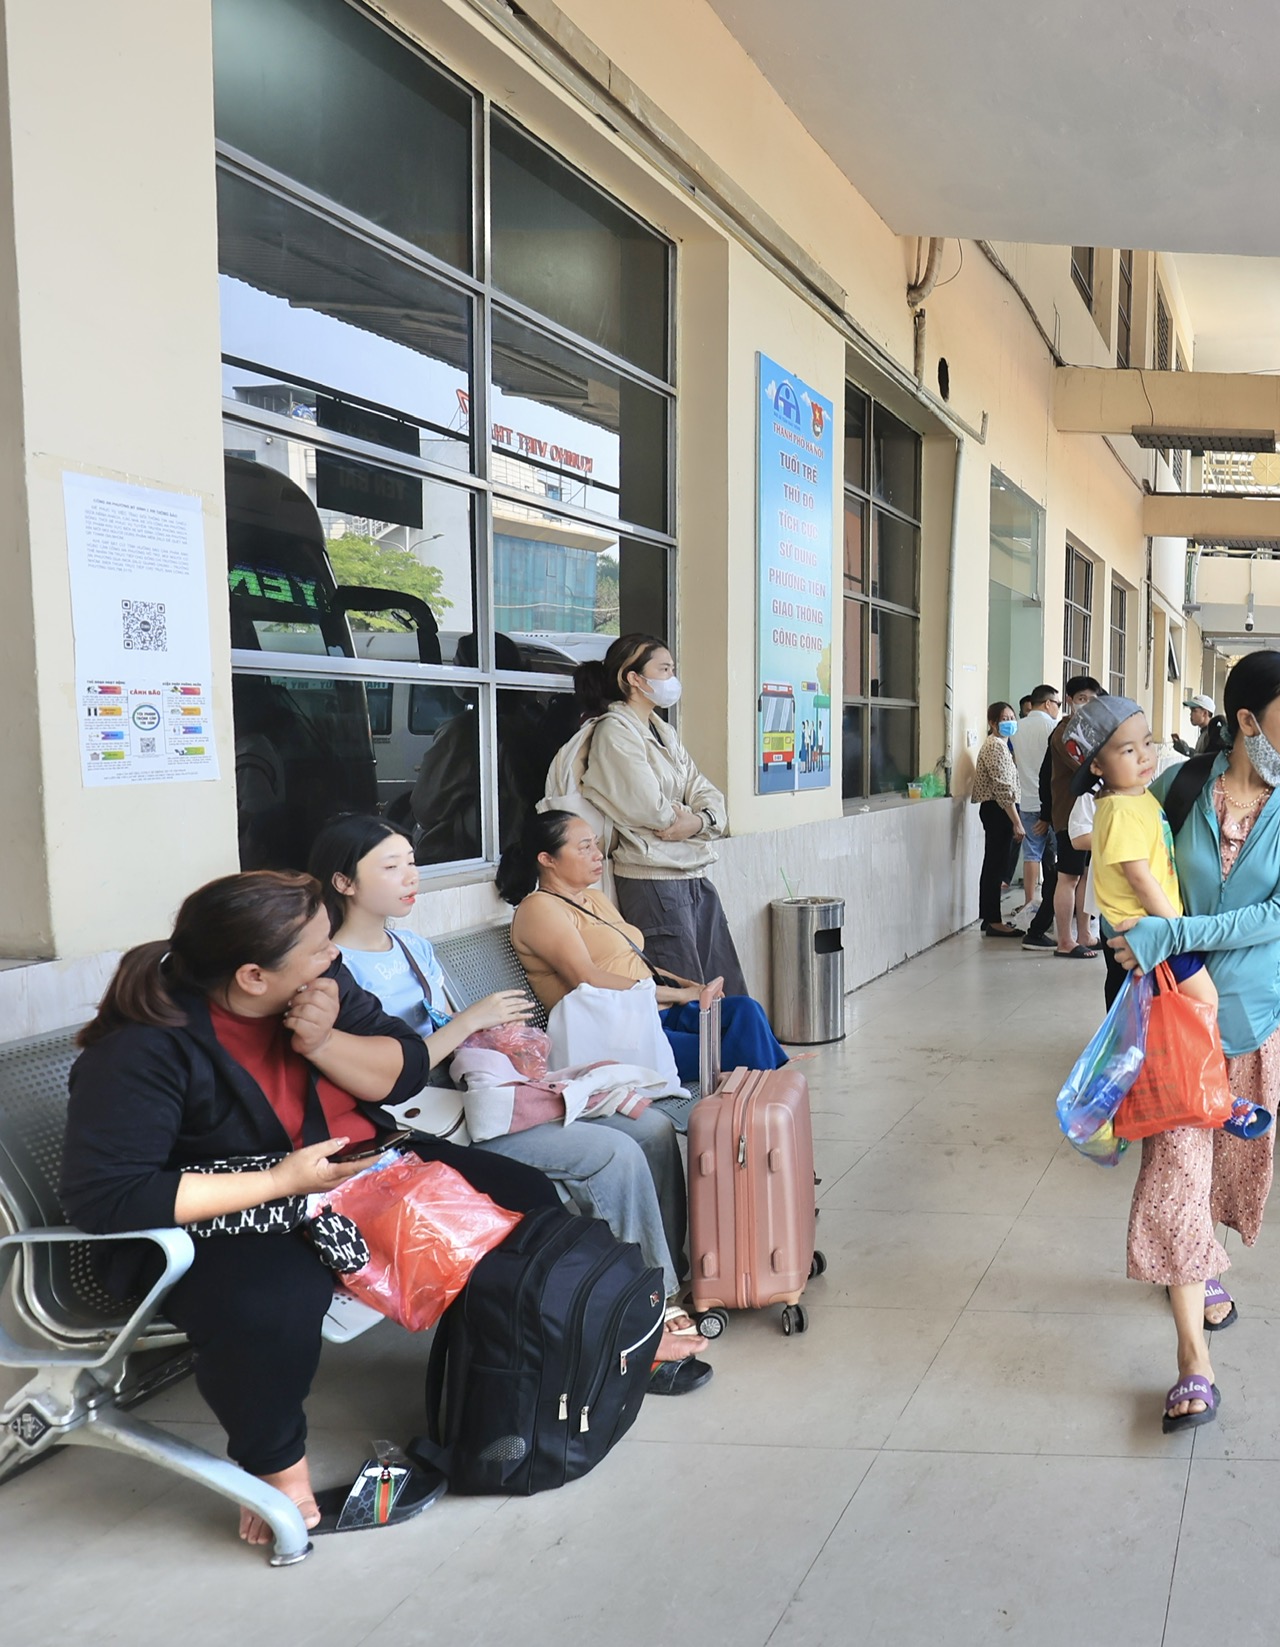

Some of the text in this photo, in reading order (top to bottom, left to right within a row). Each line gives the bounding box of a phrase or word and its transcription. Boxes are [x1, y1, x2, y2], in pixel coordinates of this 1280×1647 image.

[780, 451, 818, 484] TUỔI TRẺ
[783, 484, 801, 504] THỦ
[779, 511, 799, 532] TÍCH
[779, 541, 794, 558] SỬ
[769, 568, 806, 592] PHƯƠNG
[772, 599, 823, 625] GIAO THÔNG
[772, 628, 823, 654] CÔNG CỘNG
[1169, 1380, 1208, 1402] Chloé
